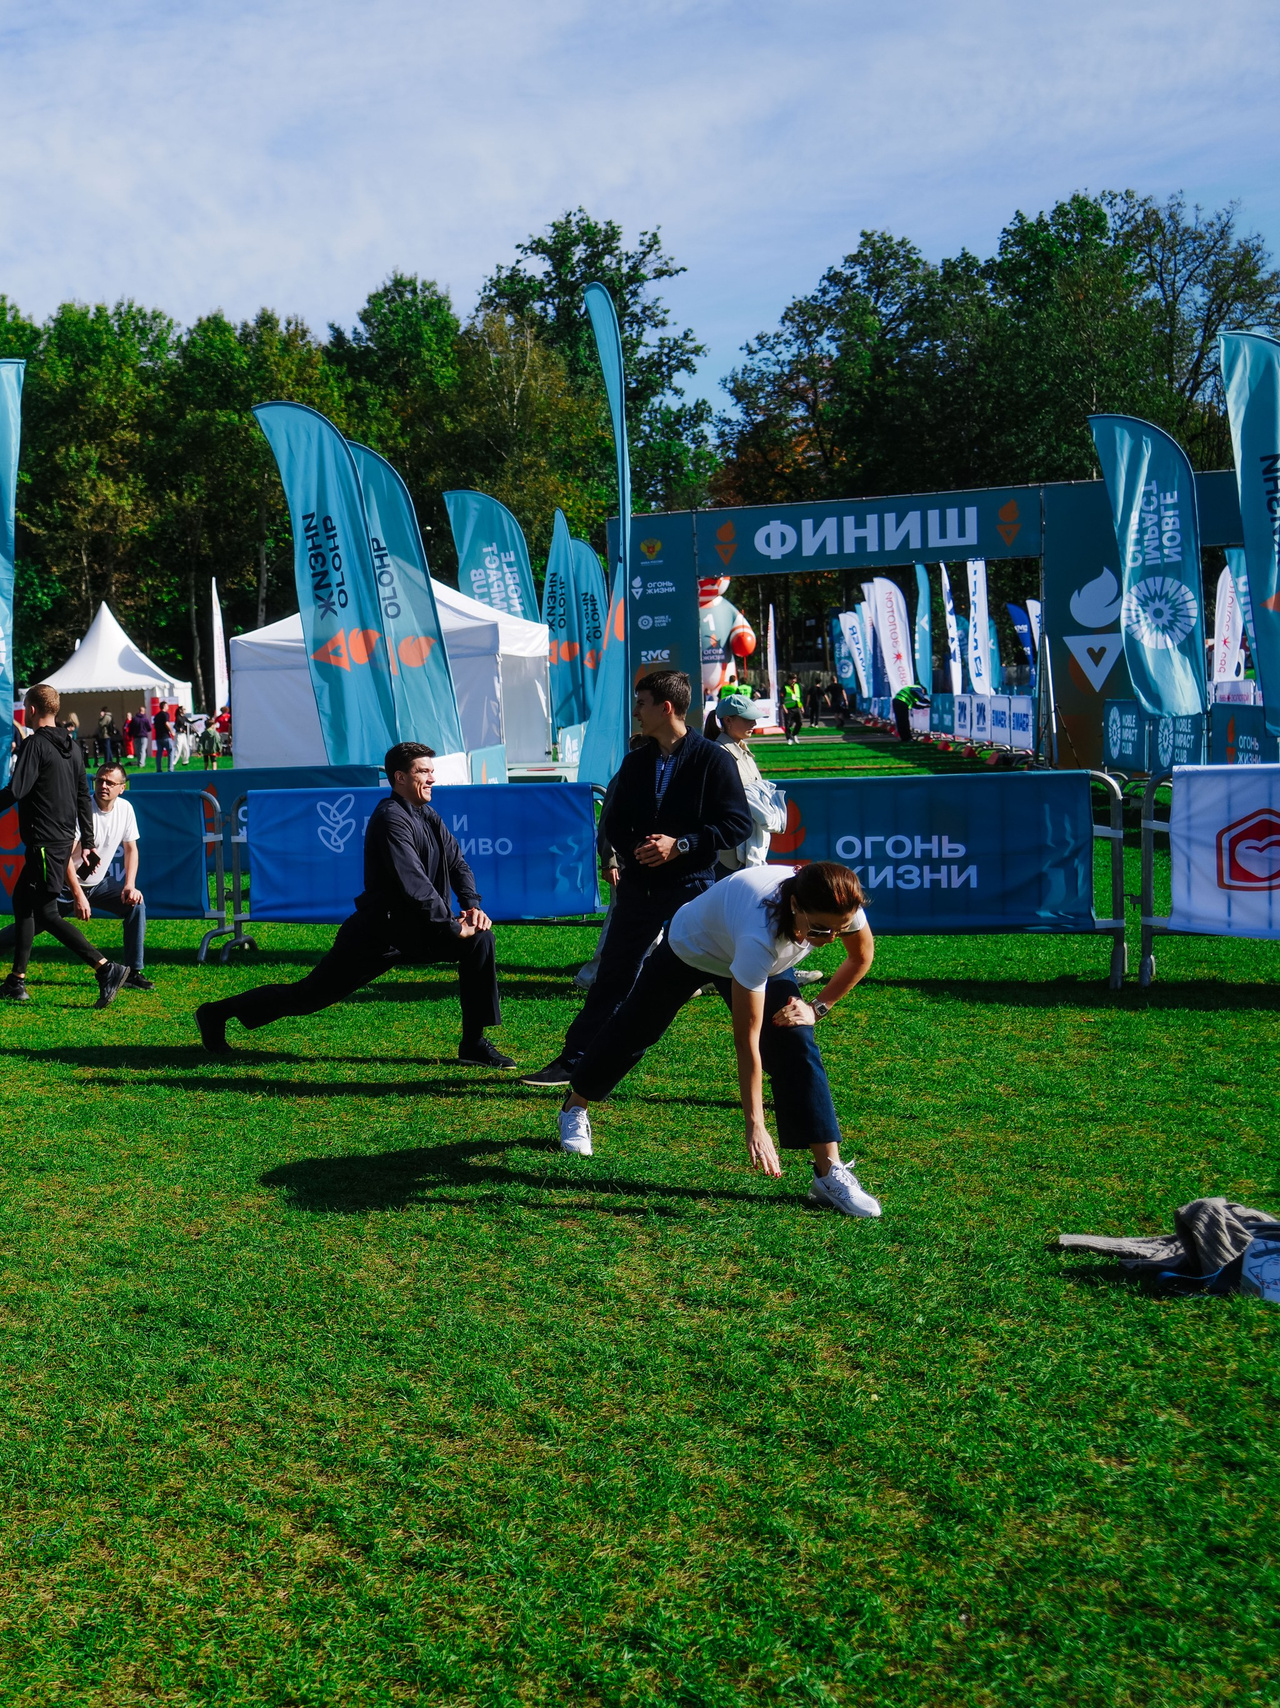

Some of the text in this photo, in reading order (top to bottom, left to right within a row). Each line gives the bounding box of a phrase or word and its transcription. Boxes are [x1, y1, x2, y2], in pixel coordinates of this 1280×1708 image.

[754, 506, 978, 560] ФИНИШ
[646, 587, 676, 595] ЖИЗНИ
[703, 614, 716, 631] 1
[1122, 715, 1136, 728] NOBLE
[1175, 717, 1192, 732] NOBLE
[1121, 728, 1138, 741] IMPACT
[1174, 734, 1195, 748] IMPACT
[1121, 742, 1133, 755] CLUB
[1238, 735, 1260, 751] ОГОНЬ
[1174, 749, 1188, 763] CLUB
[452, 814, 468, 832] И
[835, 835, 967, 859] ОГОНЬ
